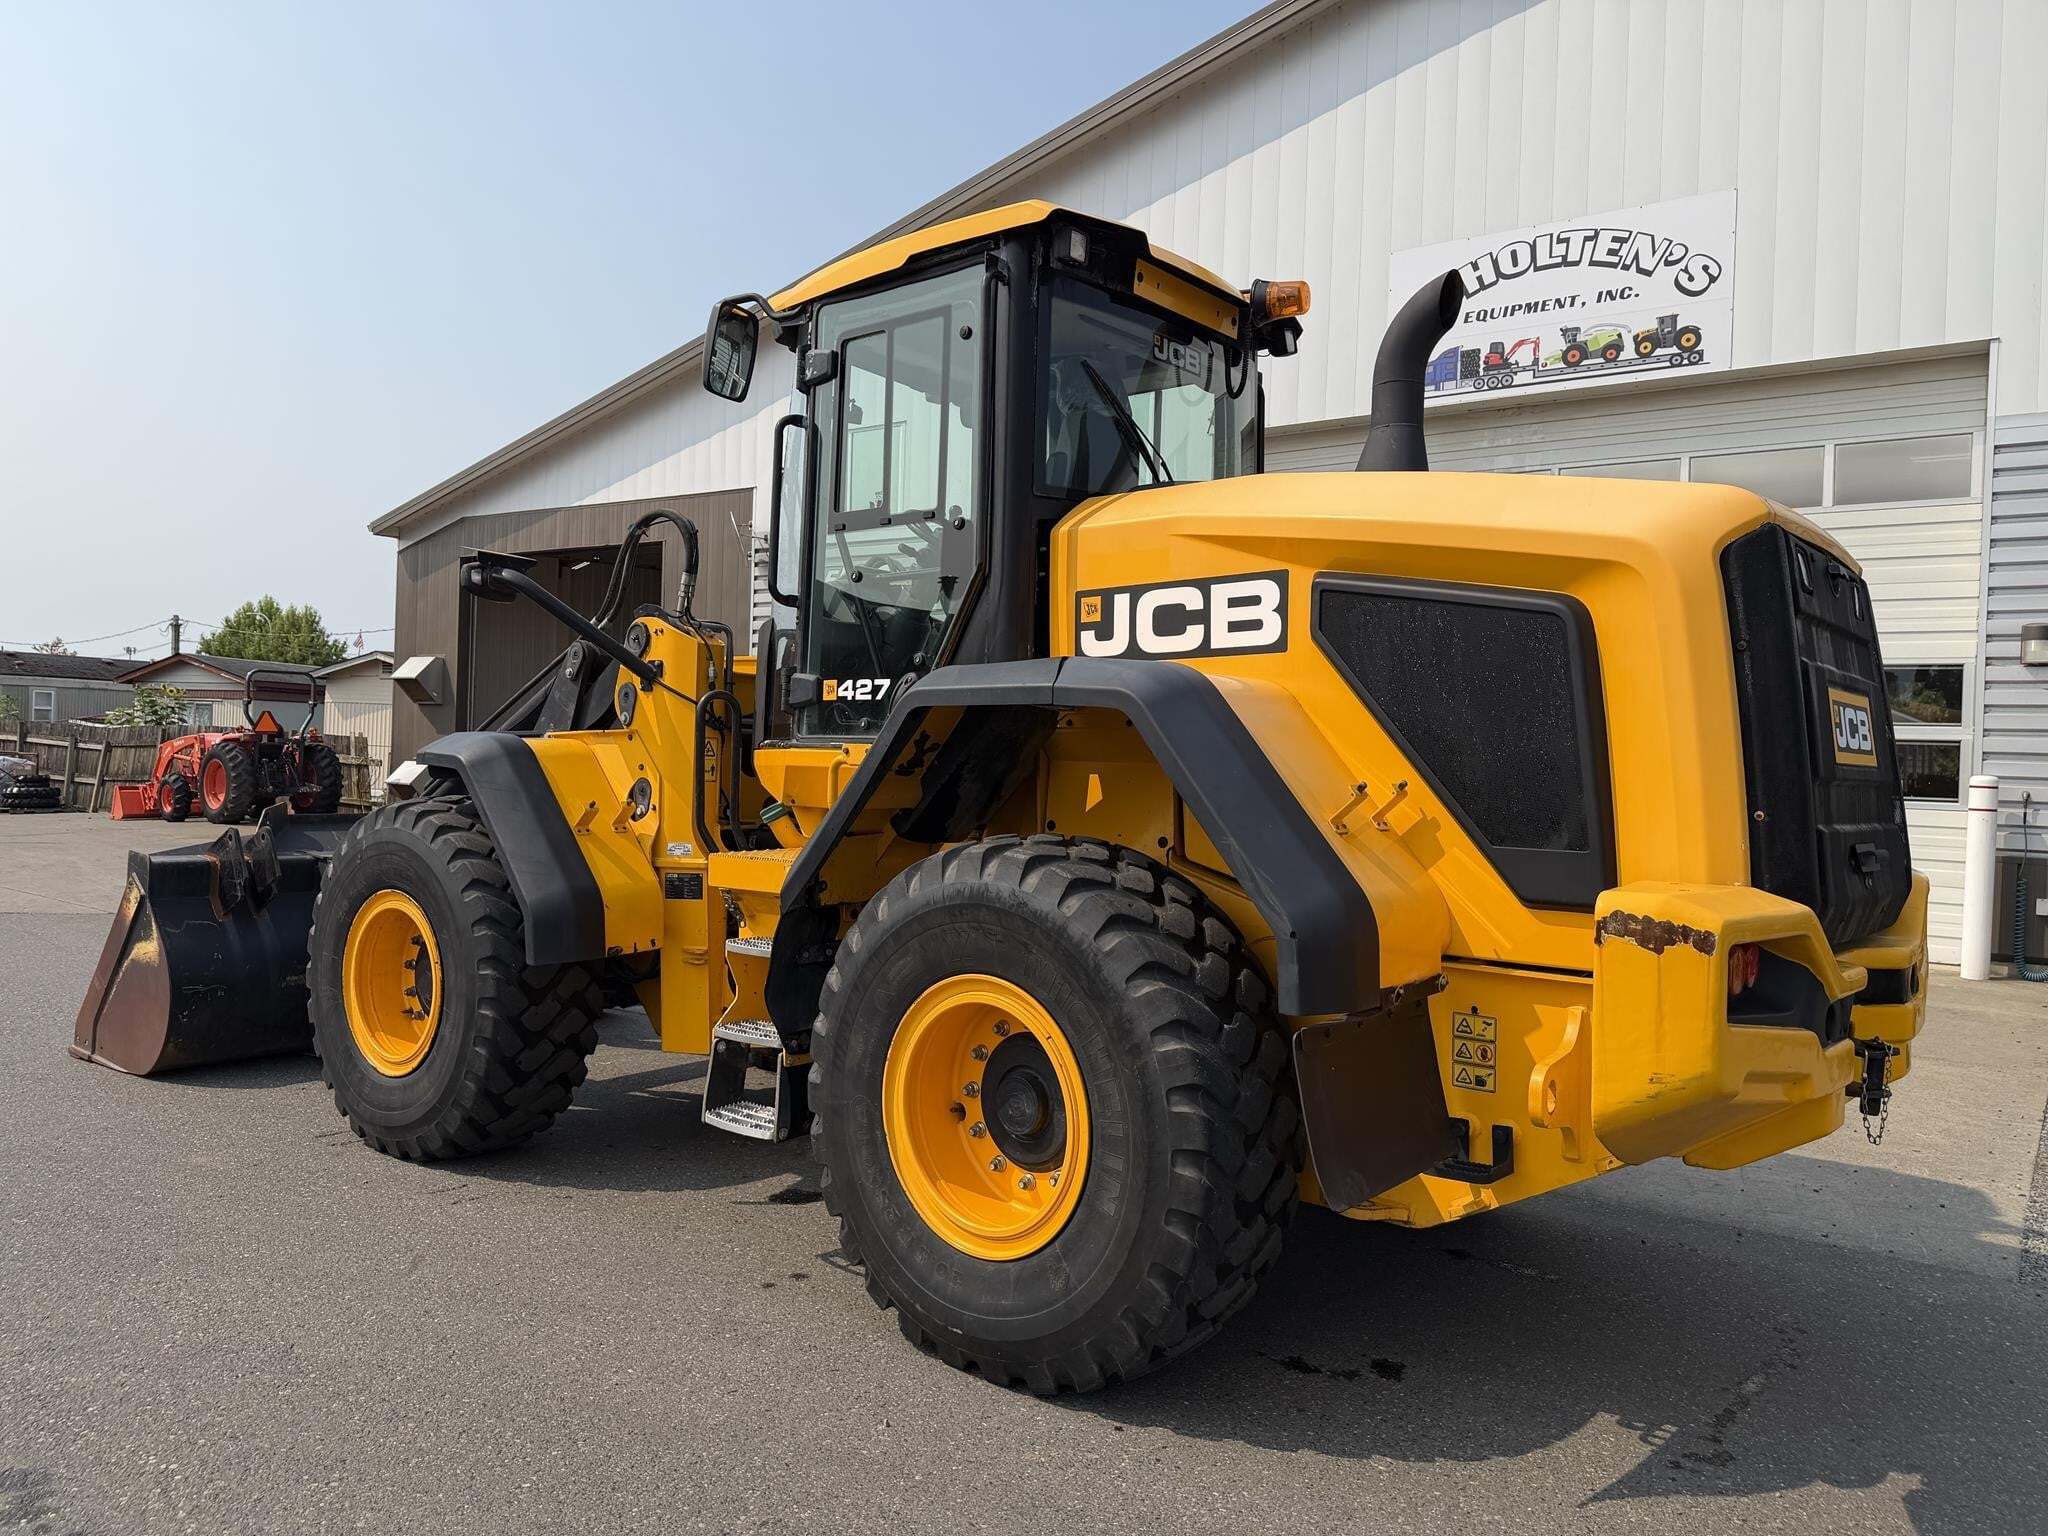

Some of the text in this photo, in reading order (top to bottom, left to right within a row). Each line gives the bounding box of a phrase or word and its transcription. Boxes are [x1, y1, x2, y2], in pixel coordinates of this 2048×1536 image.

[1457, 228, 1722, 299] HOLTEN'S
[1463, 285, 1640, 324] EQUIPMENT, INC.
[1153, 335, 1201, 376] JCB
[1080, 579, 1282, 657] JCB
[838, 678, 891, 700] 427
[1836, 705, 1872, 750] JCB
